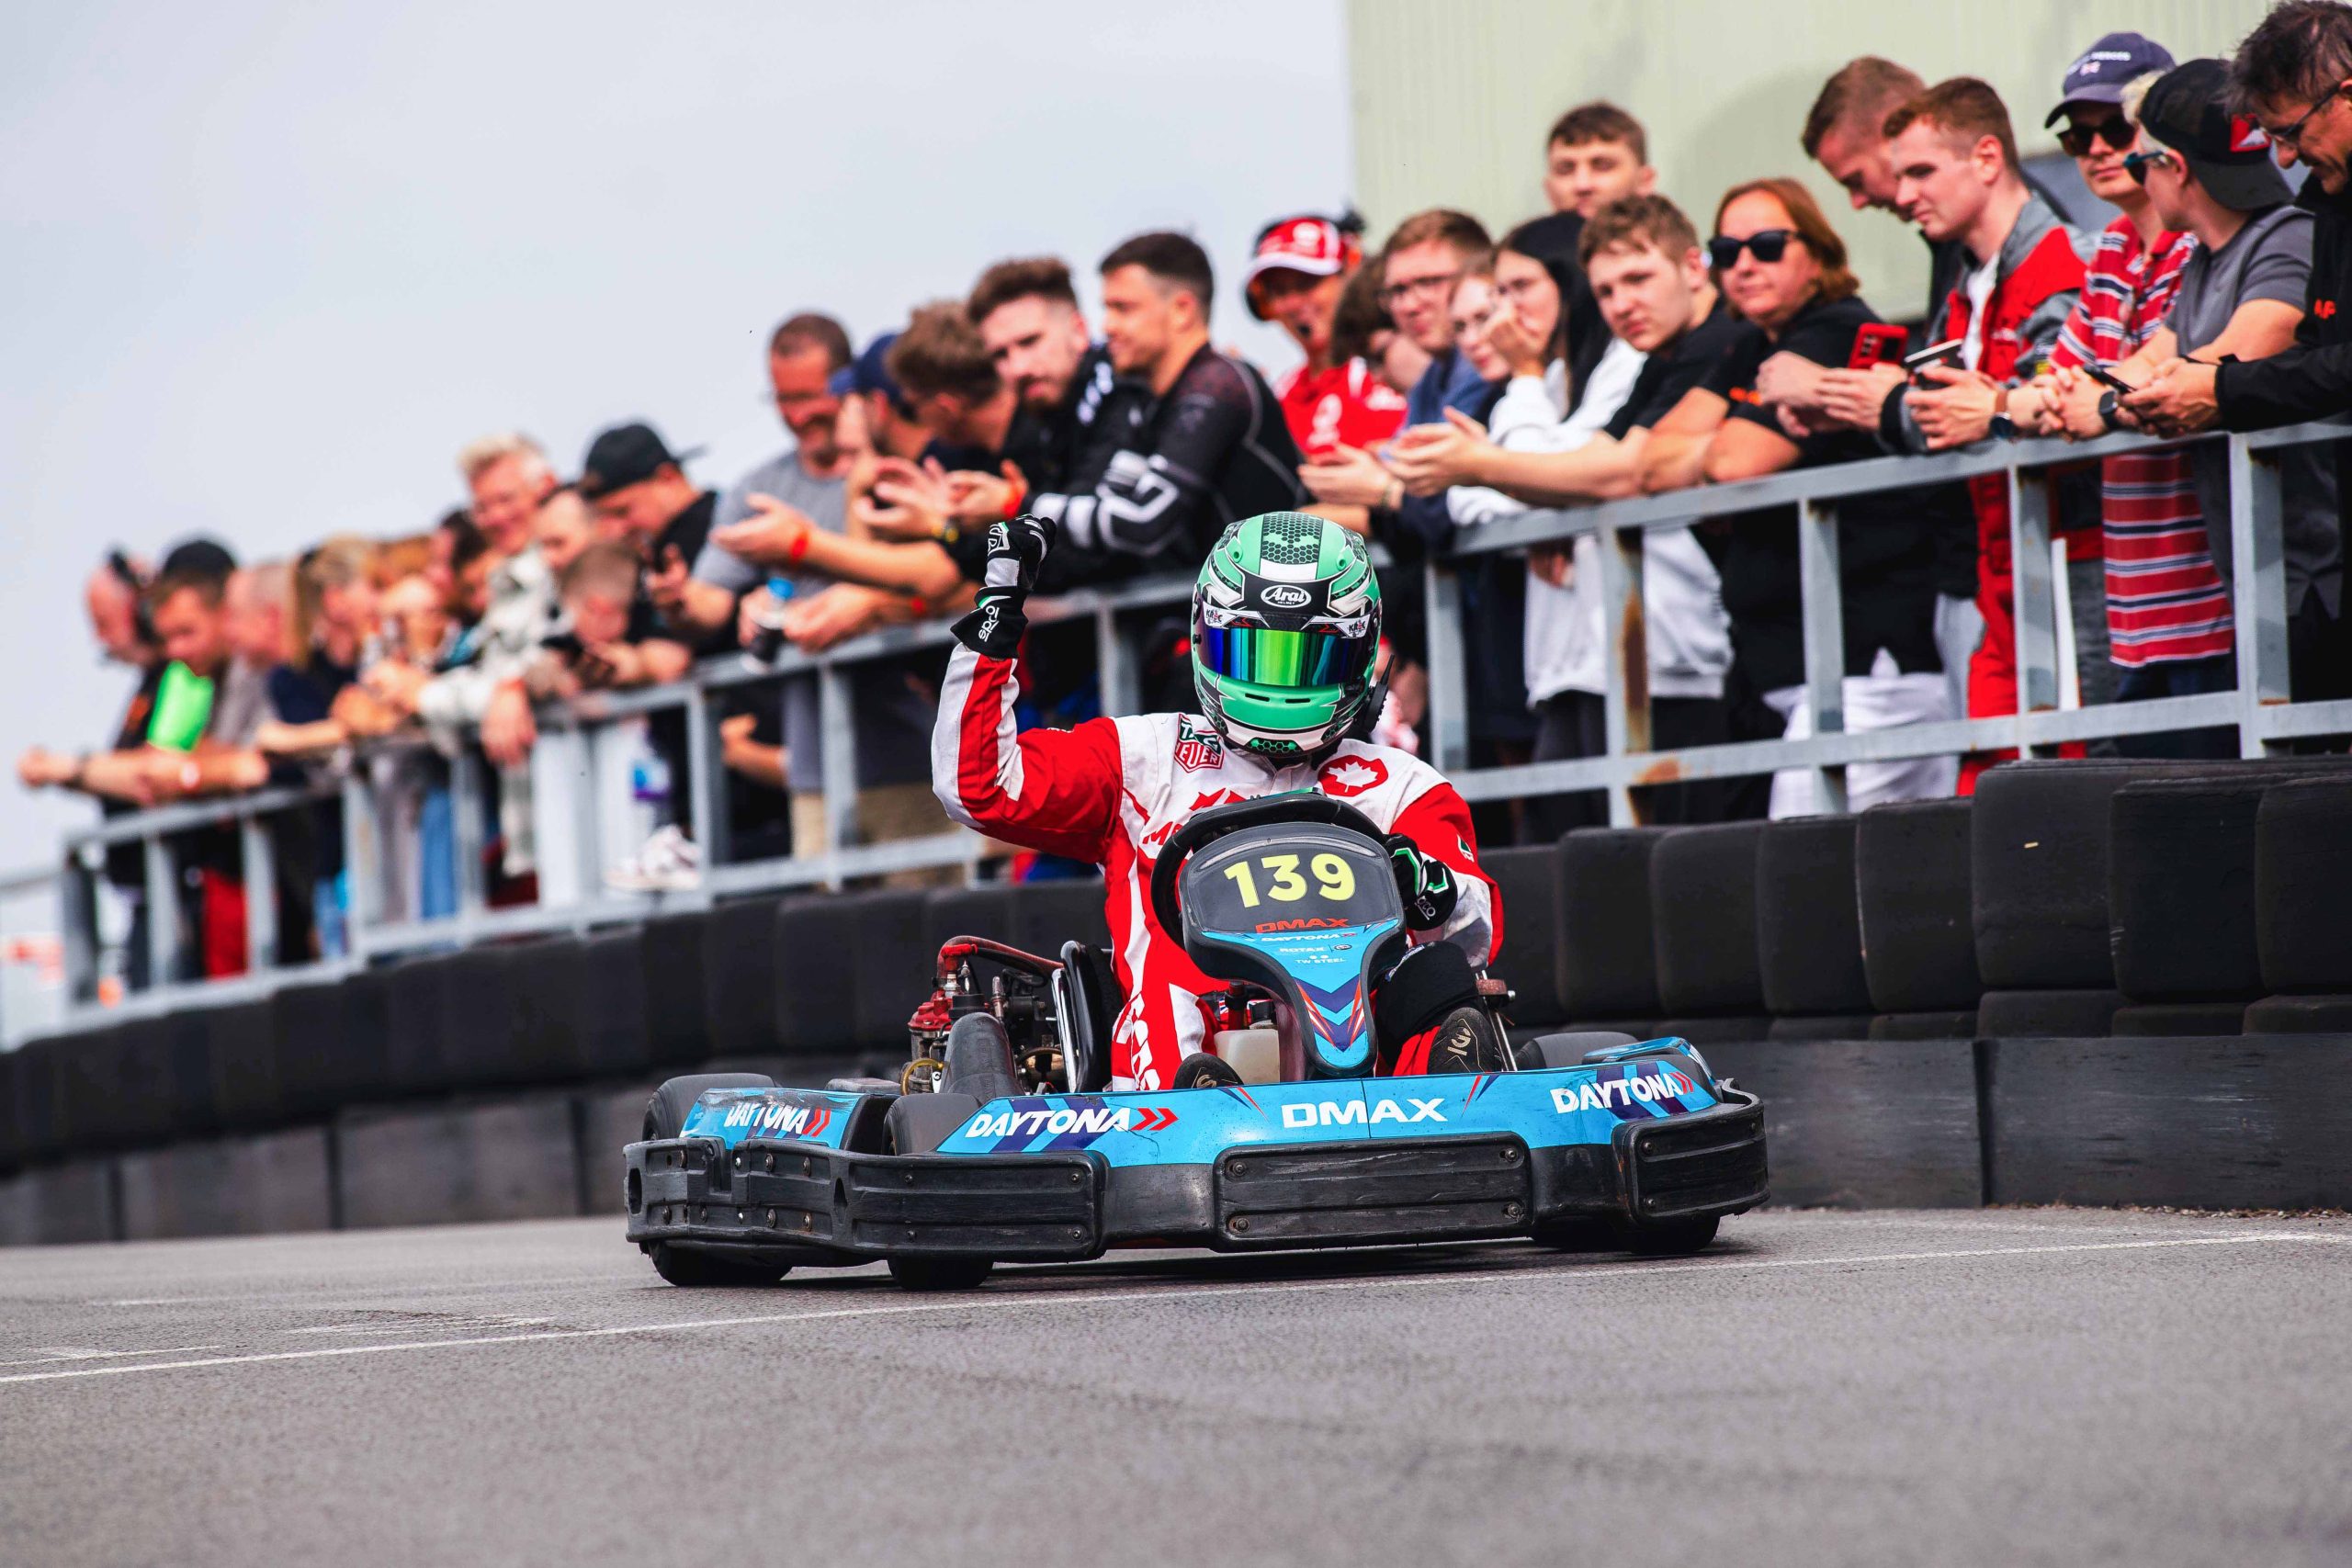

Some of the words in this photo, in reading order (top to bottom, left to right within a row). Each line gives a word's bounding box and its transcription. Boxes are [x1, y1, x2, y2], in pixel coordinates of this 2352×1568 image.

[1264, 586, 1306, 603] Arai
[1223, 852, 1356, 908] 139
[1255, 918, 1350, 934] DMAX
[1261, 933, 1340, 942] DAYTONA
[1549, 1073, 1684, 1114] DAYTONA
[965, 1107, 1131, 1138] DAYTONA
[1281, 1098, 1449, 1129] DMAX
